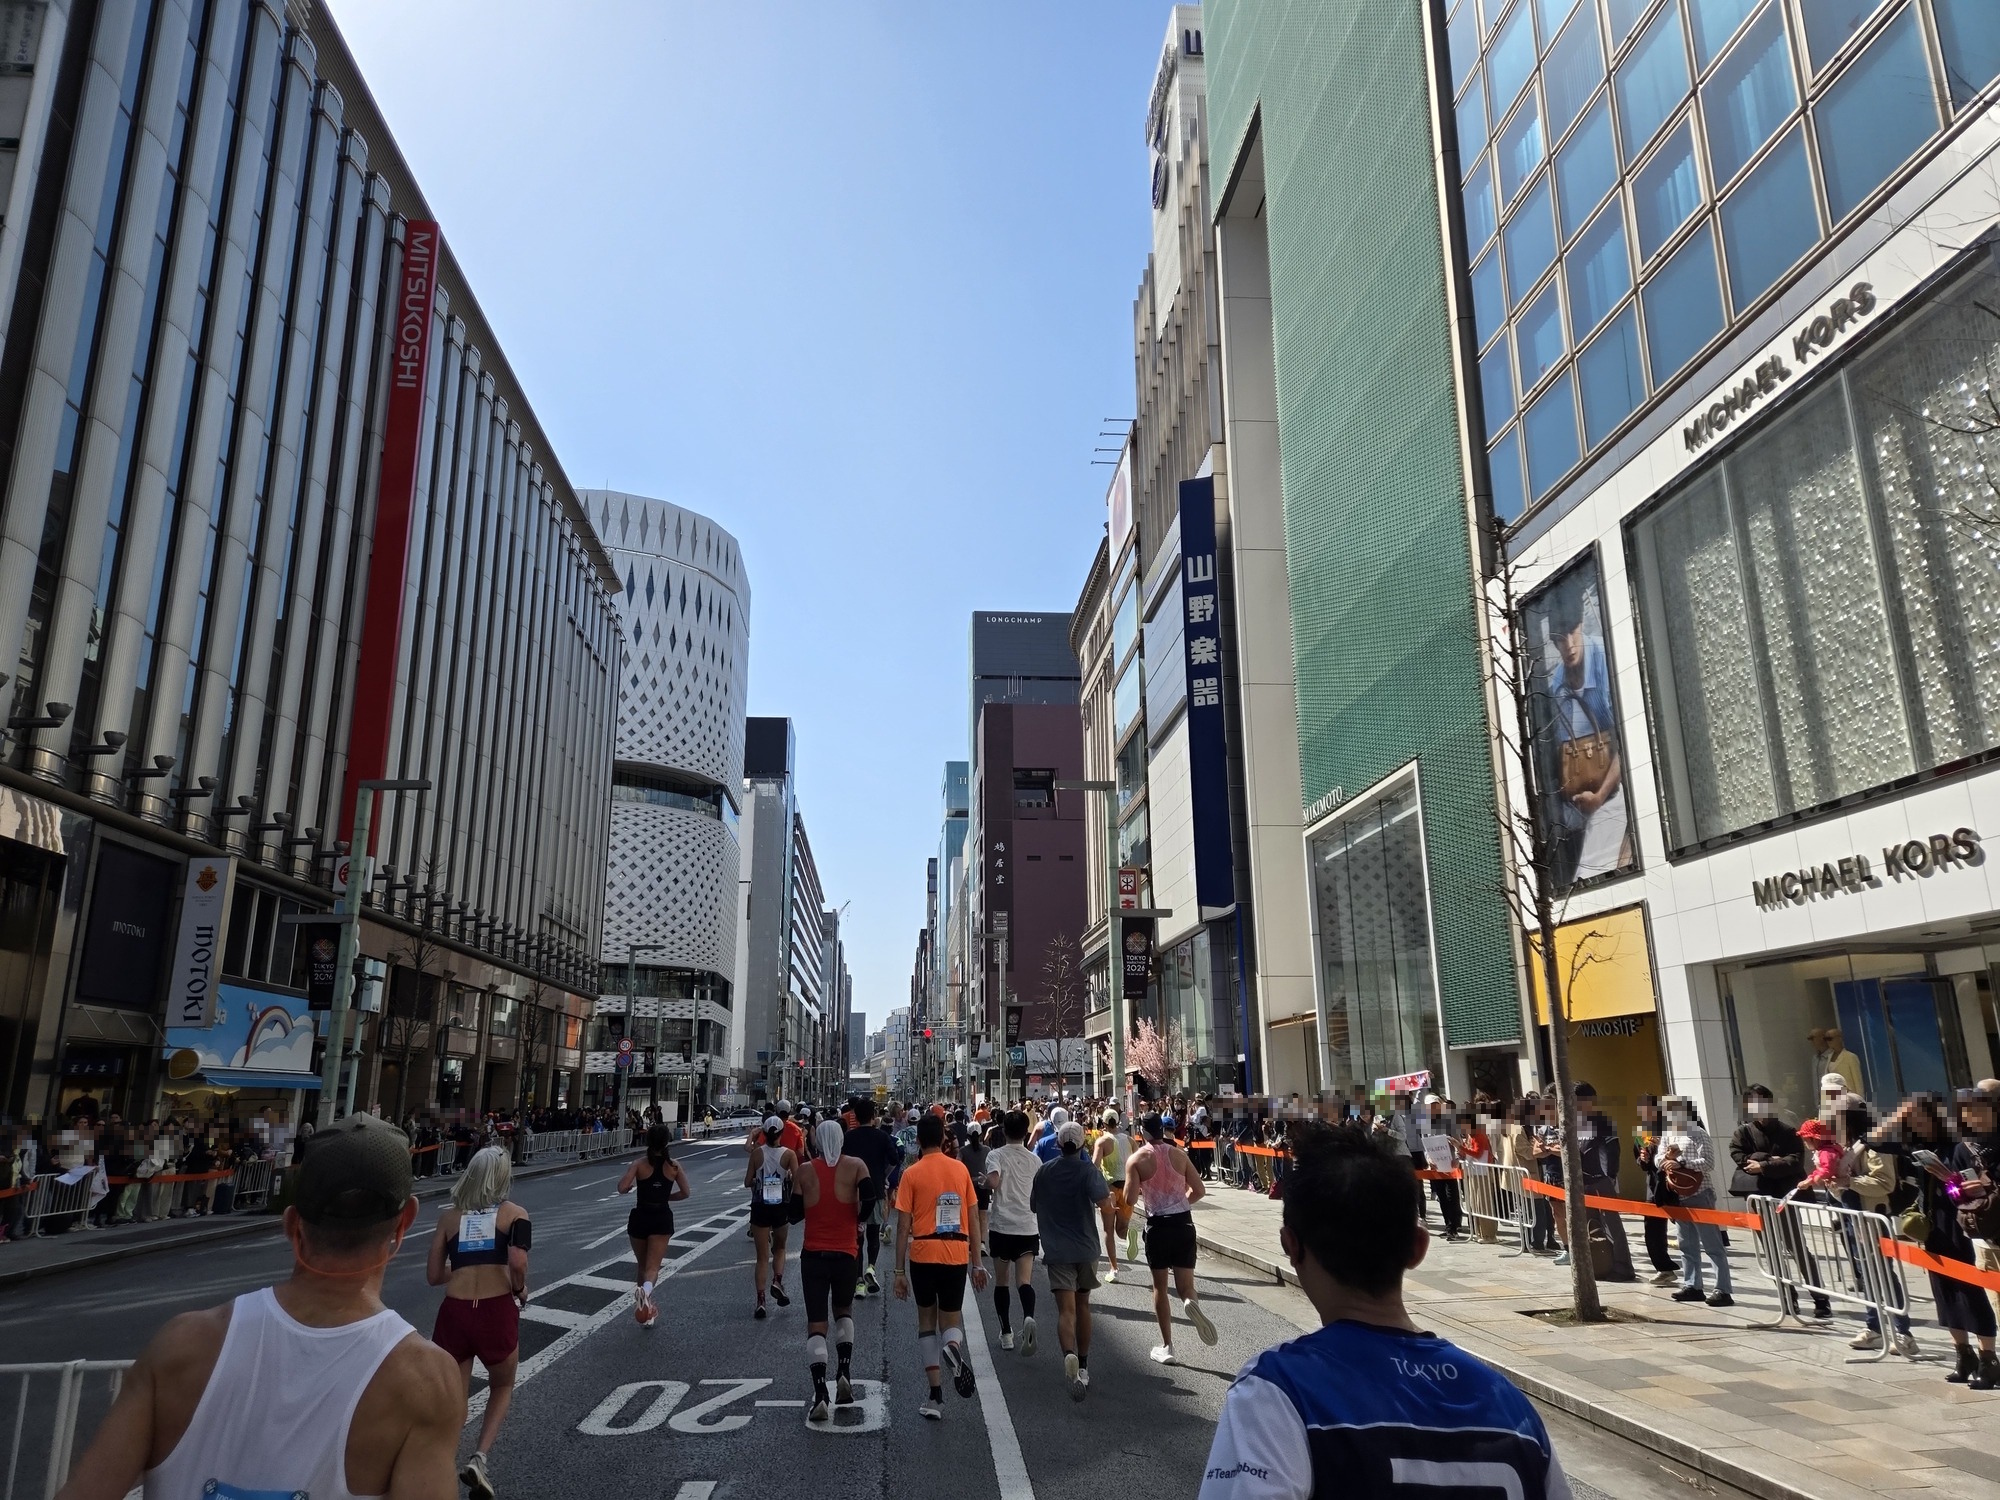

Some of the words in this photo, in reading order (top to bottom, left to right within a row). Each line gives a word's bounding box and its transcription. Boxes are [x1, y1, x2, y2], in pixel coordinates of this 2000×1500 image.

[397, 232, 432, 388] MITSUKOSHI
[1683, 354, 1792, 454] MICHAEL
[1792, 281, 1877, 365] KORS
[986, 616, 1042, 624] LONGCHAMP
[1187, 554, 1219, 707] 山野楽器
[1303, 786, 1342, 823] MIKIMOTO
[1752, 853, 1876, 909] MICHAEL
[1883, 827, 1980, 877] KORS
[1126, 964, 1146, 972] 2026
[1581, 1022, 1612, 1037] WAKO
[1613, 1017, 1636, 1037] SITE
[1390, 1357, 1458, 1381] TOKYO
